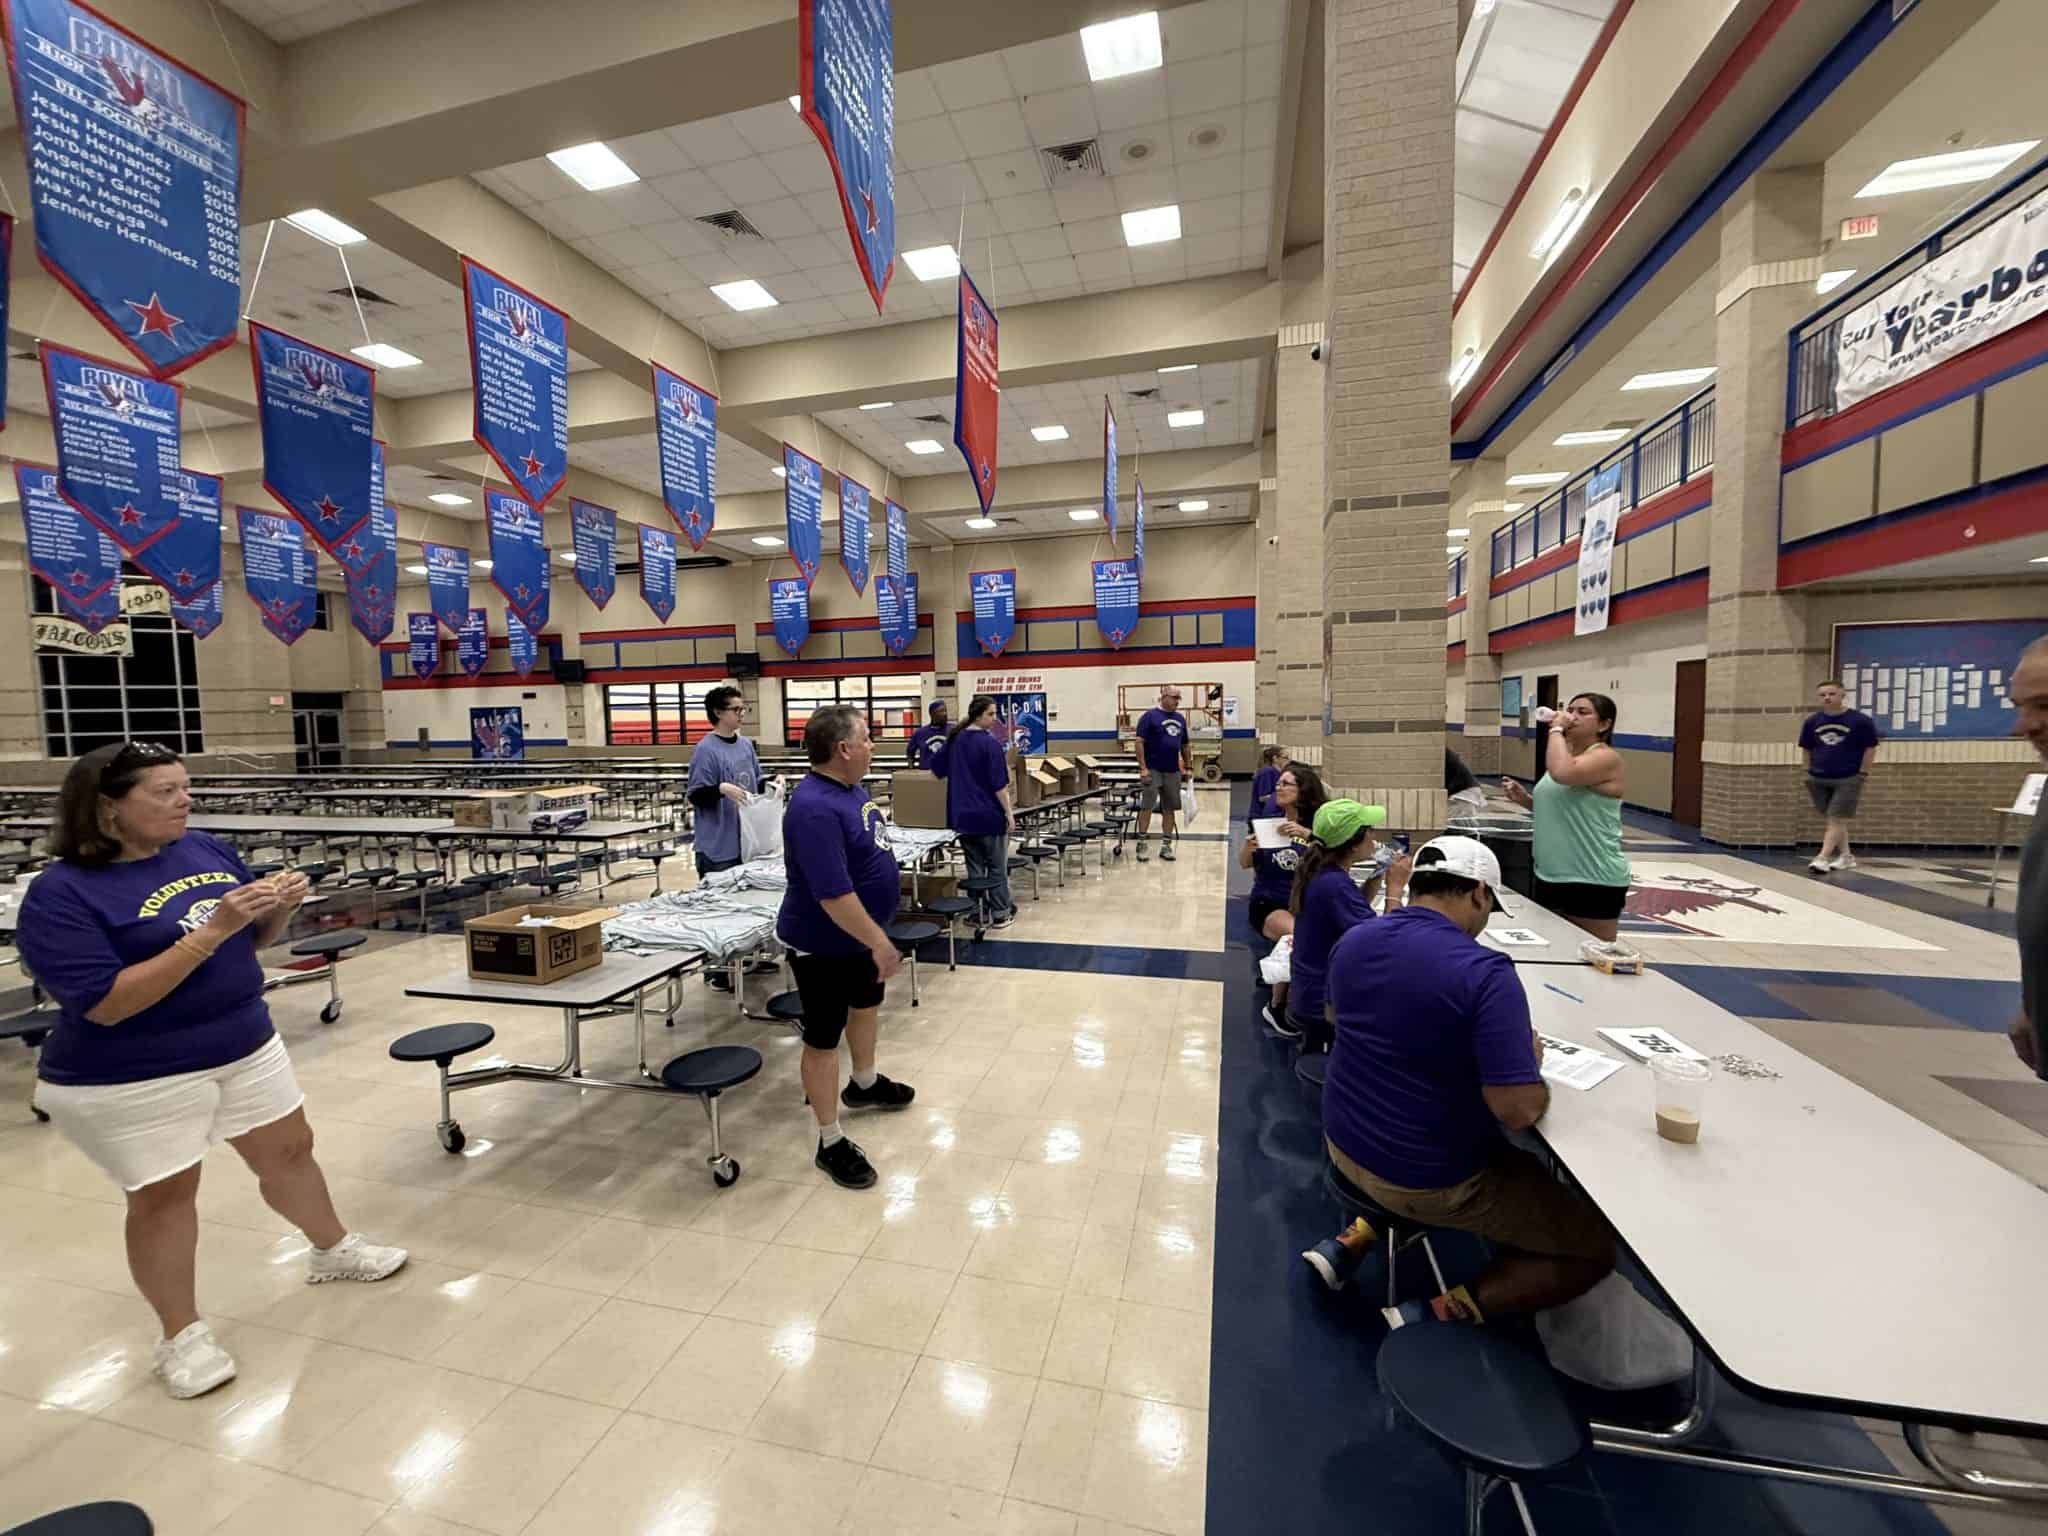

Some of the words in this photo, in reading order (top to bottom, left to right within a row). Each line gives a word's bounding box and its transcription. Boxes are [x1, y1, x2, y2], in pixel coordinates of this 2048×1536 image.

[38, 37, 84, 73] HIGH
[171, 115, 226, 153] SCHOOL
[93, 100, 152, 138] SOCIAL
[31, 90, 79, 124] Jesus
[86, 119, 172, 172] Hernandez
[203, 180, 235, 203] 2013
[31, 106, 80, 139] Jesus
[86, 133, 172, 185] Hernandez
[203, 194, 237, 217] 2015
[32, 142, 105, 182] Angeles
[111, 178, 160, 209] Garcia
[34, 158, 91, 192] Martin
[97, 187, 168, 227] Mendoza
[124, 167, 161, 194] Price
[35, 173, 72, 199] Max
[78, 194, 146, 230] Arteaga
[40, 192, 111, 230] Jennifer
[117, 223, 199, 269] Hernandez
[80, 366, 149, 404] ROYAL
[284, 347, 347, 390] ROYAL
[34, 623, 127, 650] FALCONS
[1001, 698, 1042, 717] LCON
[1630, 1033, 1681, 1055] 755
